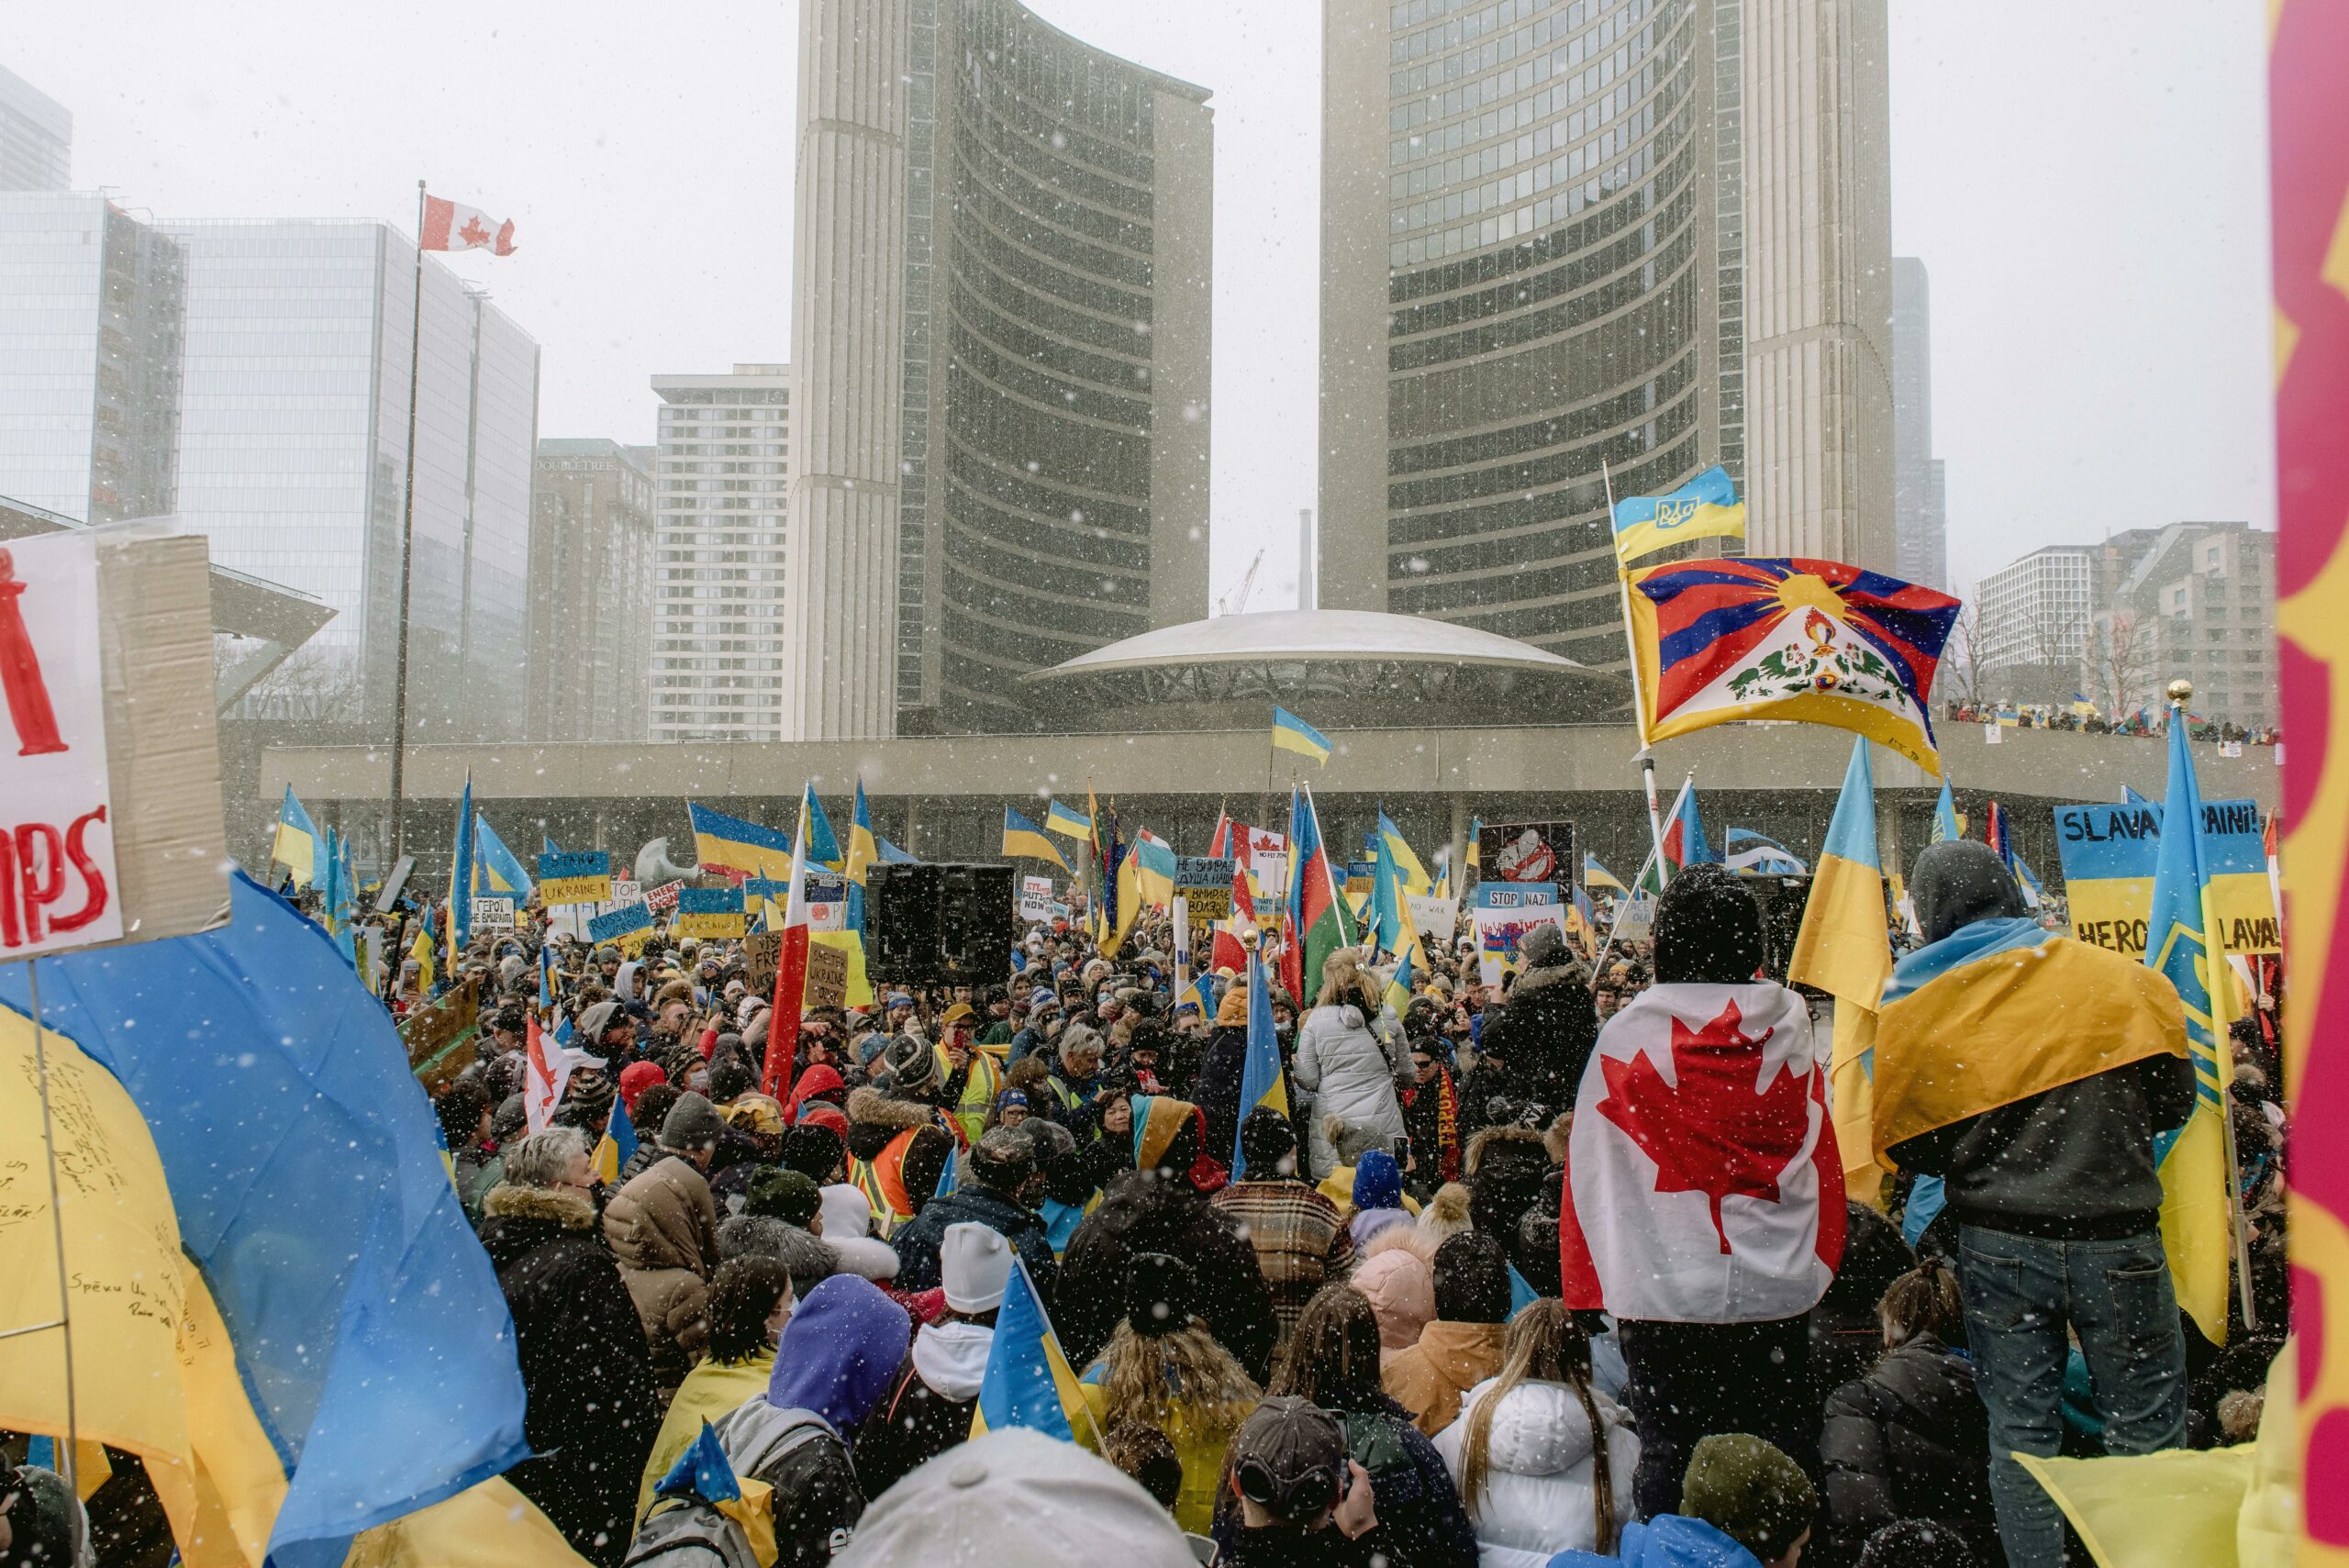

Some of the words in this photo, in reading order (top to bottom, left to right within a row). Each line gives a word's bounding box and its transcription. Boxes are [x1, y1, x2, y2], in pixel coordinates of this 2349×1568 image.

[2065, 806, 2161, 842] SLAVA
[551, 853, 595, 867] STAND
[1268, 851, 1276, 860] FLY
[1176, 857, 1191, 872] НЕ
[1178, 872, 1209, 884] ДУША
[477, 899, 505, 913] ГЕРОЇ
[1491, 892, 1518, 906] STOP
[1525, 894, 1549, 906] NAZI
[1409, 903, 1421, 911] NO
[1428, 905, 1445, 915] WAR
[2218, 917, 2282, 949] LAVA!
[813, 949, 845, 969] SHELTER
[809, 968, 844, 987] UKRAINE
